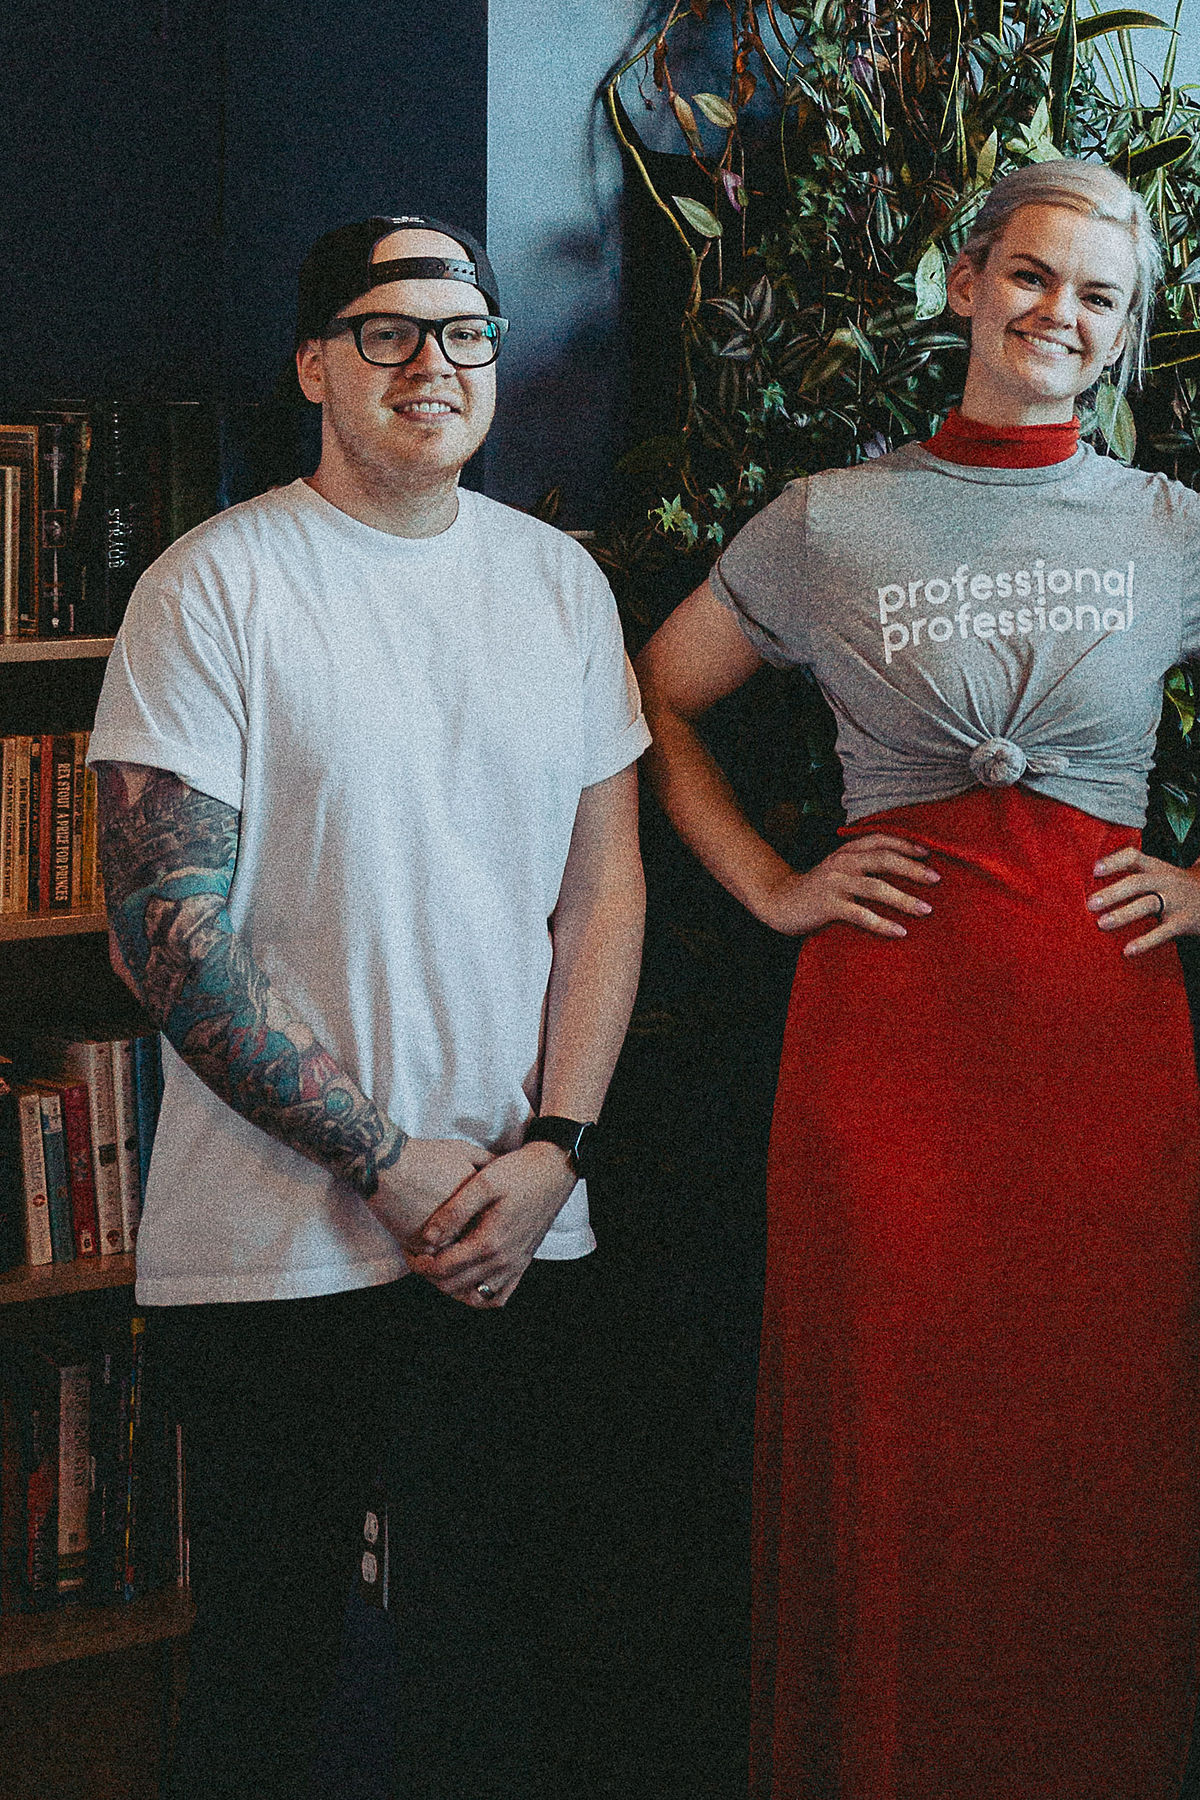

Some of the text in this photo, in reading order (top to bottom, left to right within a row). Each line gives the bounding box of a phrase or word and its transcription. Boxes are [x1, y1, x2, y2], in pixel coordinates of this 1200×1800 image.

[108, 508, 122, 568] STRAUB
[877, 560, 1134, 624] professional
[882, 596, 1133, 664] professional
[57, 763, 71, 779] REX
[57, 781, 71, 808] STOUT
[55, 820, 70, 844] PRIZE
[55, 846, 70, 864] FOR
[55, 865, 70, 901] PRINCES
